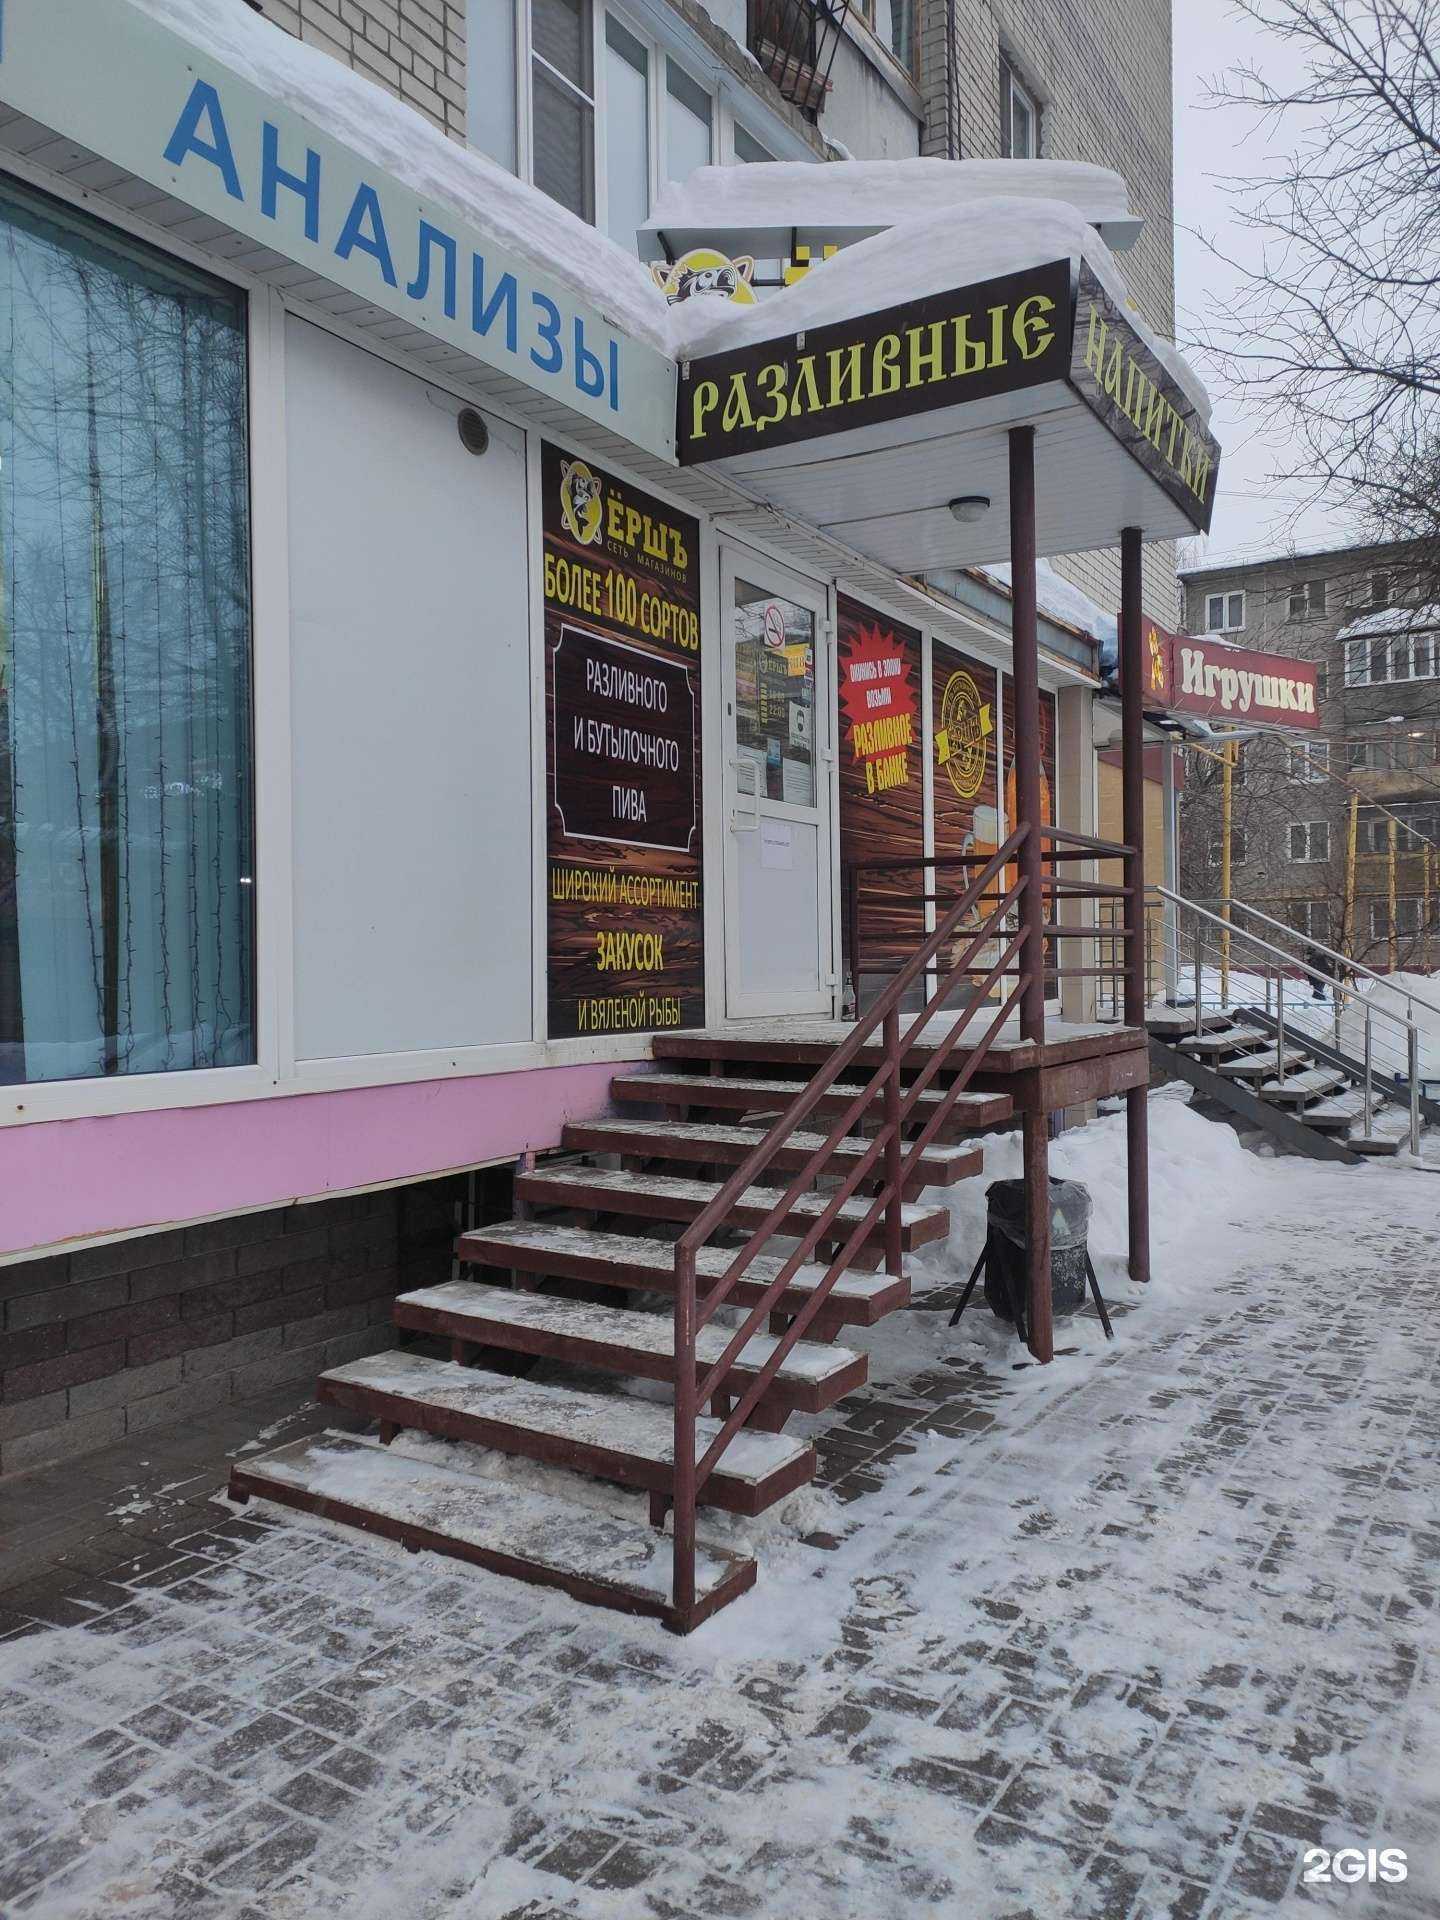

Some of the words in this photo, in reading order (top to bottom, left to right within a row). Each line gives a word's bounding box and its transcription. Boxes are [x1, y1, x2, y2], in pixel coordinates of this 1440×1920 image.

[163, 79, 620, 412] АНАЛИЗЫ
[689, 295, 1057, 440] РАЗЛИВНЫЕ
[1083, 302, 1212, 504] НАПИТКИ
[606, 488, 688, 570] ЁРШЪ
[607, 540, 629, 558] СЕТЬ
[637, 554, 688, 584] МАГАЗИНОВ
[545, 552, 602, 616] БОЛЕЕ
[605, 569, 637, 627] 100
[640, 592, 699, 651] СОРТОВ
[586, 658, 668, 713] РАЗЛИВНОГО
[1180, 648, 1315, 713] Игрушки
[574, 715, 584, 750] И
[587, 719, 679, 772] БУТЫЛОЧНОГО
[853, 713, 913, 758] РАЗЛИВНОЕ
[866, 761, 875, 795] В
[875, 752, 909, 791] БАНКЕ
[612, 786, 647, 822] ПИВА
[552, 866, 617, 903] ШИРОКИЙ
[619, 874, 699, 909] АССОРТИМЕНТ
[596, 931, 664, 971] ЗАКУСОК
[578, 1000, 587, 1030] И
[591, 990, 646, 1030] ВЯЛЕНОЙ
[649, 998, 681, 1026] РЫБЫ
